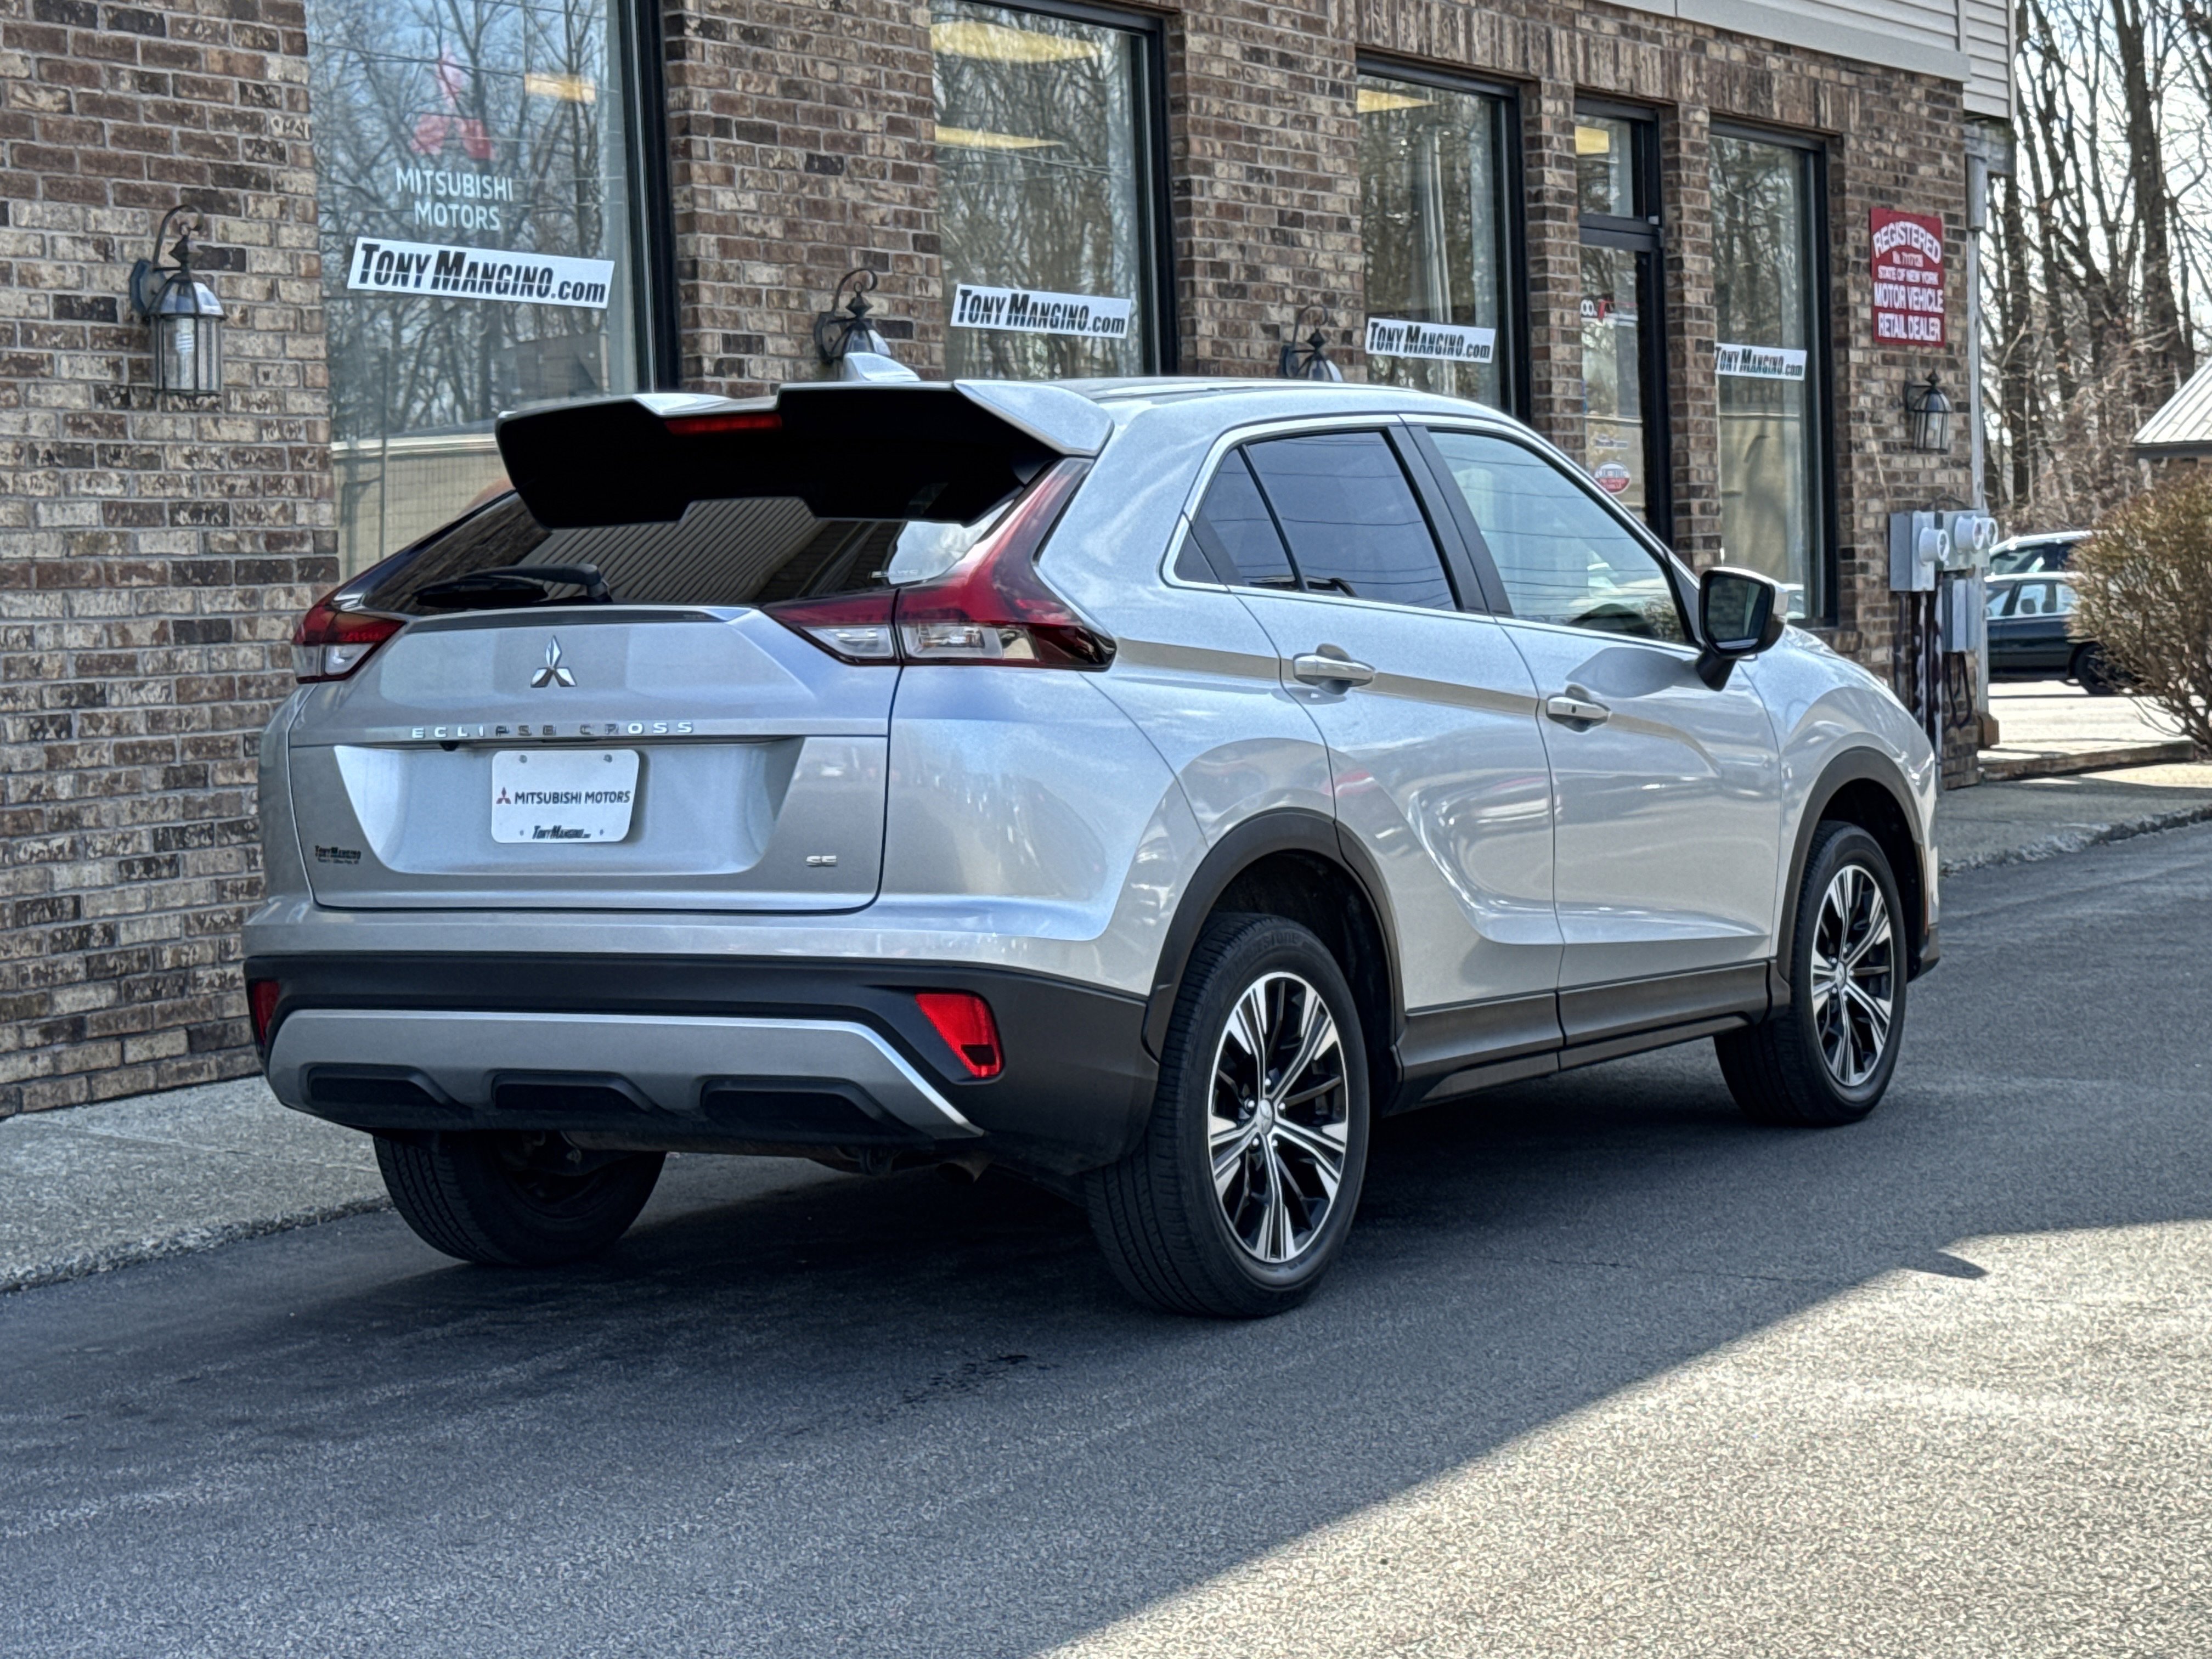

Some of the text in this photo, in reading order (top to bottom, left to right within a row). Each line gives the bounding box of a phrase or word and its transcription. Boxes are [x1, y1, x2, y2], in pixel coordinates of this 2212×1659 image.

[396, 168, 514, 201] MITSUBISHI
[415, 202, 500, 231] MOTORS
[1873, 221, 1941, 264] REGISTERED
[1878, 265, 1896, 281] STATE
[1874, 282, 1944, 313] MOTOR VEHICLE
[1878, 312, 1941, 342] RETAIL DEALER
[411, 722, 693, 739] ECLIPSE CROSS
[515, 791, 630, 804] MITSUBISHI MOTORS
